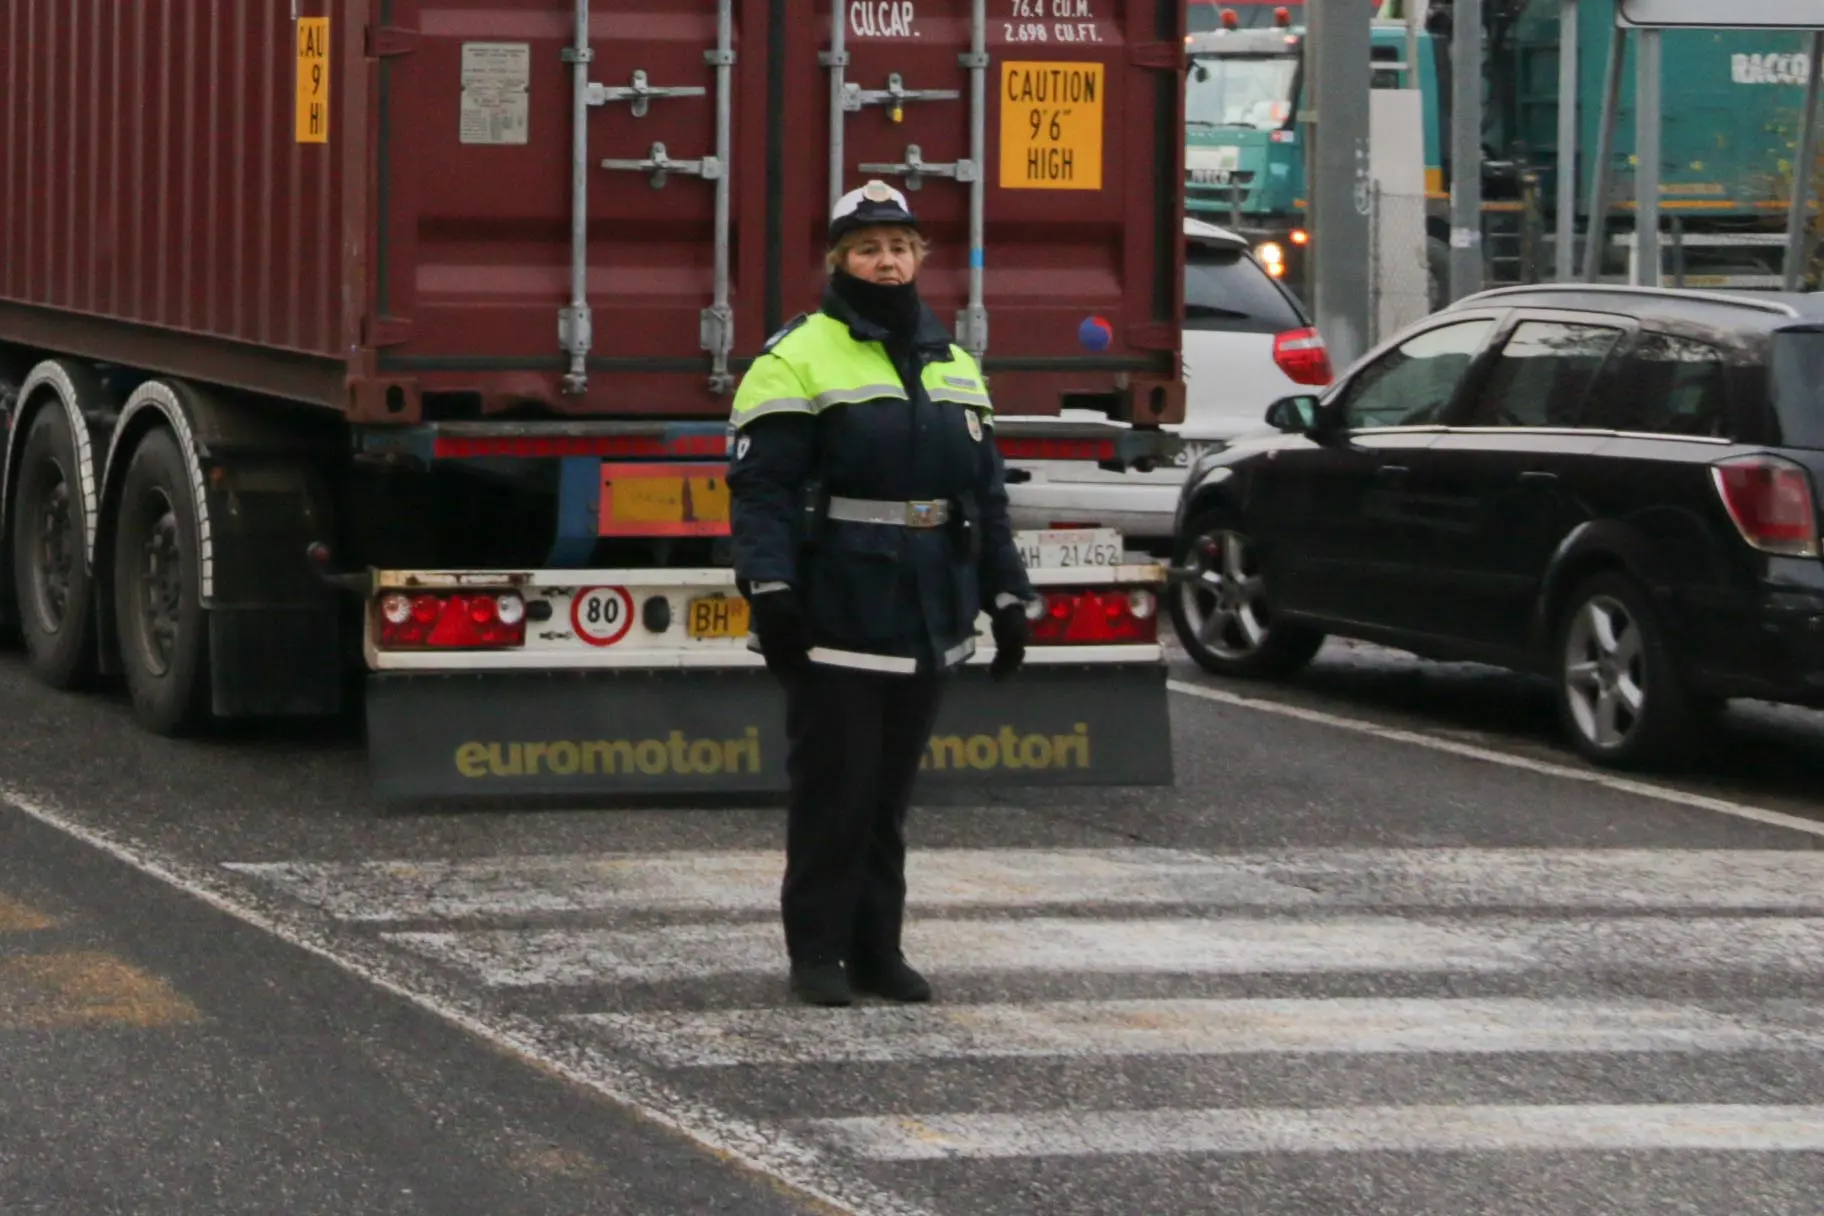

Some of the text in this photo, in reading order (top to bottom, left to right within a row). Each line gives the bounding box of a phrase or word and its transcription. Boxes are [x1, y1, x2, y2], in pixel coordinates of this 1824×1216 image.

[850, 1, 920, 38] CU.CAP.
[1008, 69, 1096, 102] CAUTION
[1027, 147, 1074, 181] HIGH
[587, 596, 619, 624] 80
[695, 602, 729, 632] BH
[455, 722, 1091, 778] euromotori motori
